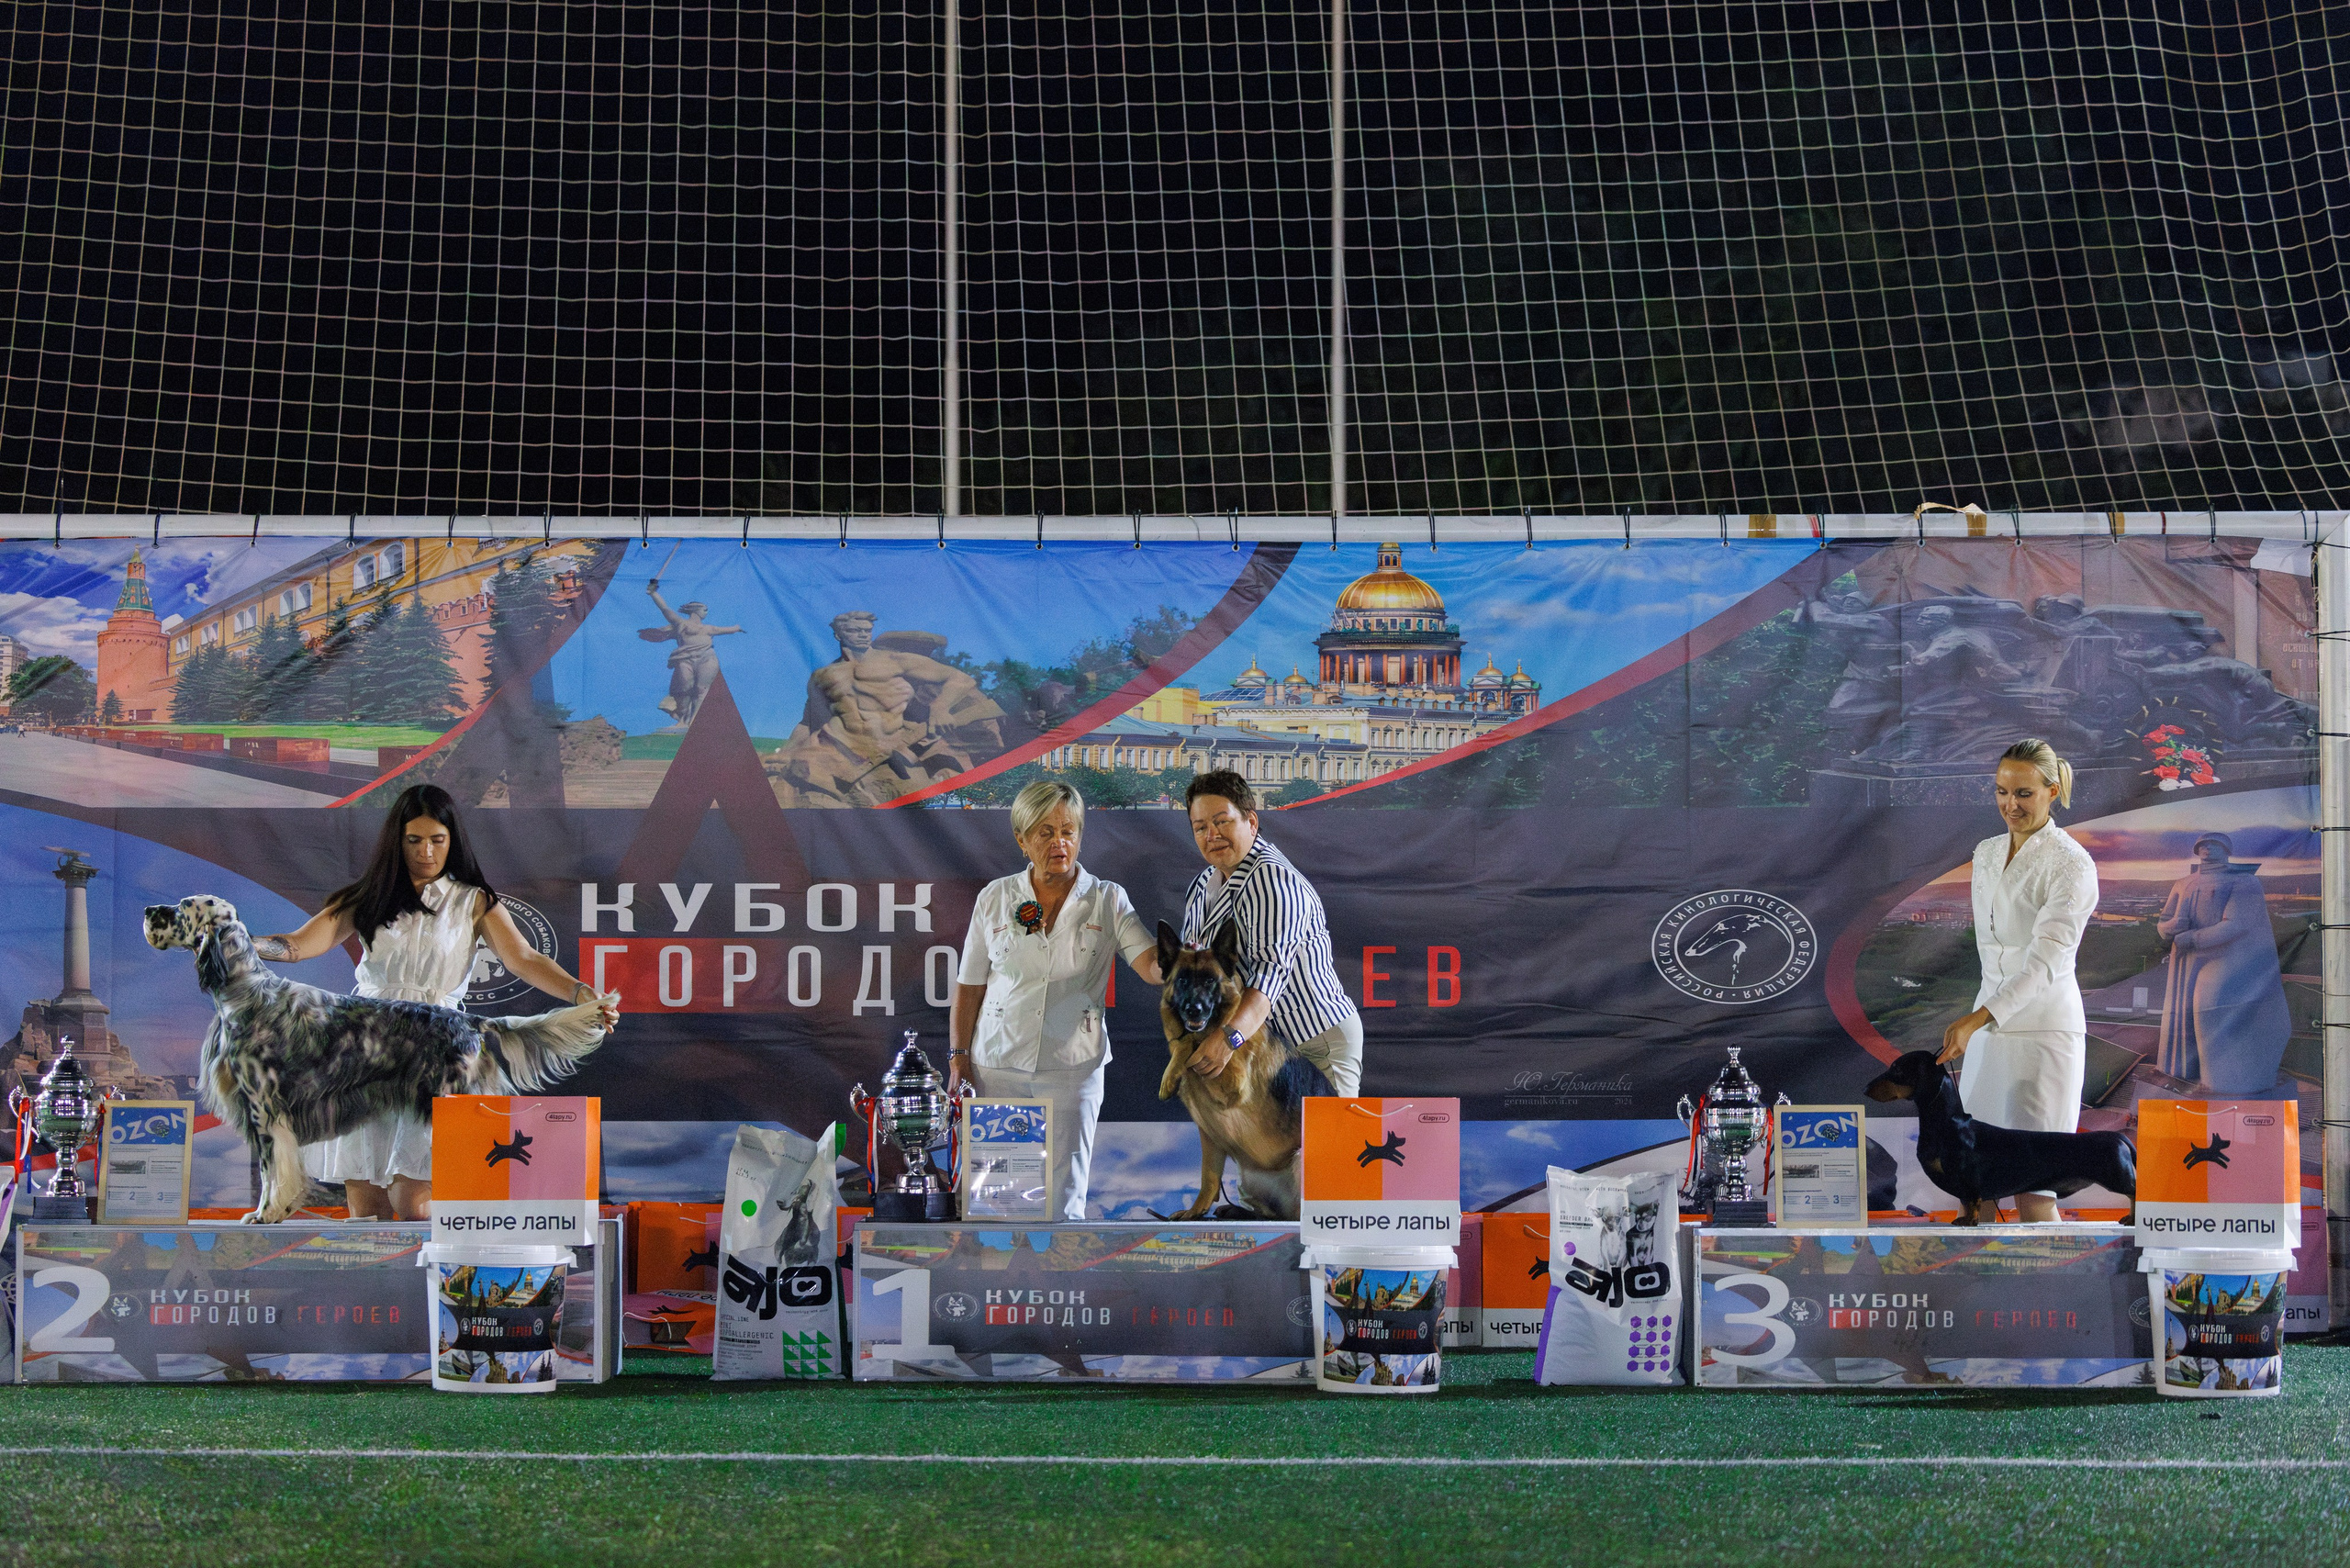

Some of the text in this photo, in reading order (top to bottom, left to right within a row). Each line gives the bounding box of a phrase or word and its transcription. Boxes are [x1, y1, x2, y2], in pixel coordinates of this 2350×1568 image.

[581, 882, 934, 933] КУБОК
[500, 897, 551, 957] БНОГО СОБАКОВ
[1659, 894, 1810, 999] РОССИЙСКАЯ КИНОЛОГИЧЕСКАЯ ФЕДЕРАЦИЯ
[594, 945, 959, 1016] ГОРОДО
[110, 1109, 186, 1143] OZON
[970, 1107, 1046, 1141] OZON
[1782, 1114, 1858, 1148] OZON
[1805, 1195, 1810, 1204] 2
[1833, 1195, 1840, 1204] 3
[441, 1215, 576, 1230] четыре лапы
[1313, 1215, 1450, 1230] четыре лапы
[2143, 1217, 2275, 1233] четыре лапы
[151, 1289, 250, 1304] КУБОК
[986, 1289, 1085, 1304] КУБОК
[1829, 1294, 1928, 1308] КУБОК
[29, 1266, 115, 1352] 2
[153, 1305, 276, 1326] ГОРОДОВ
[872, 1268, 956, 1360] 1
[989, 1306, 1111, 1327] ГОРОДОВ
[2286, 1307, 2320, 1319] апы
[472, 1316, 498, 1326] КУБОК
[1358, 1318, 1383, 1328] КУБОК
[1443, 1320, 1473, 1333] апы
[1711, 1273, 1796, 1367] 3
[1832, 1310, 1954, 1330] ГОРОДОВ
[472, 1326, 504, 1337] ГОРОДОВ
[1358, 1327, 1389, 1339] ГОРОДОВ
[1490, 1322, 1543, 1334] четыр
[2199, 1324, 2226, 1333] КУБОК
[2200, 1333, 2232, 1344] ГОРОДОВ
